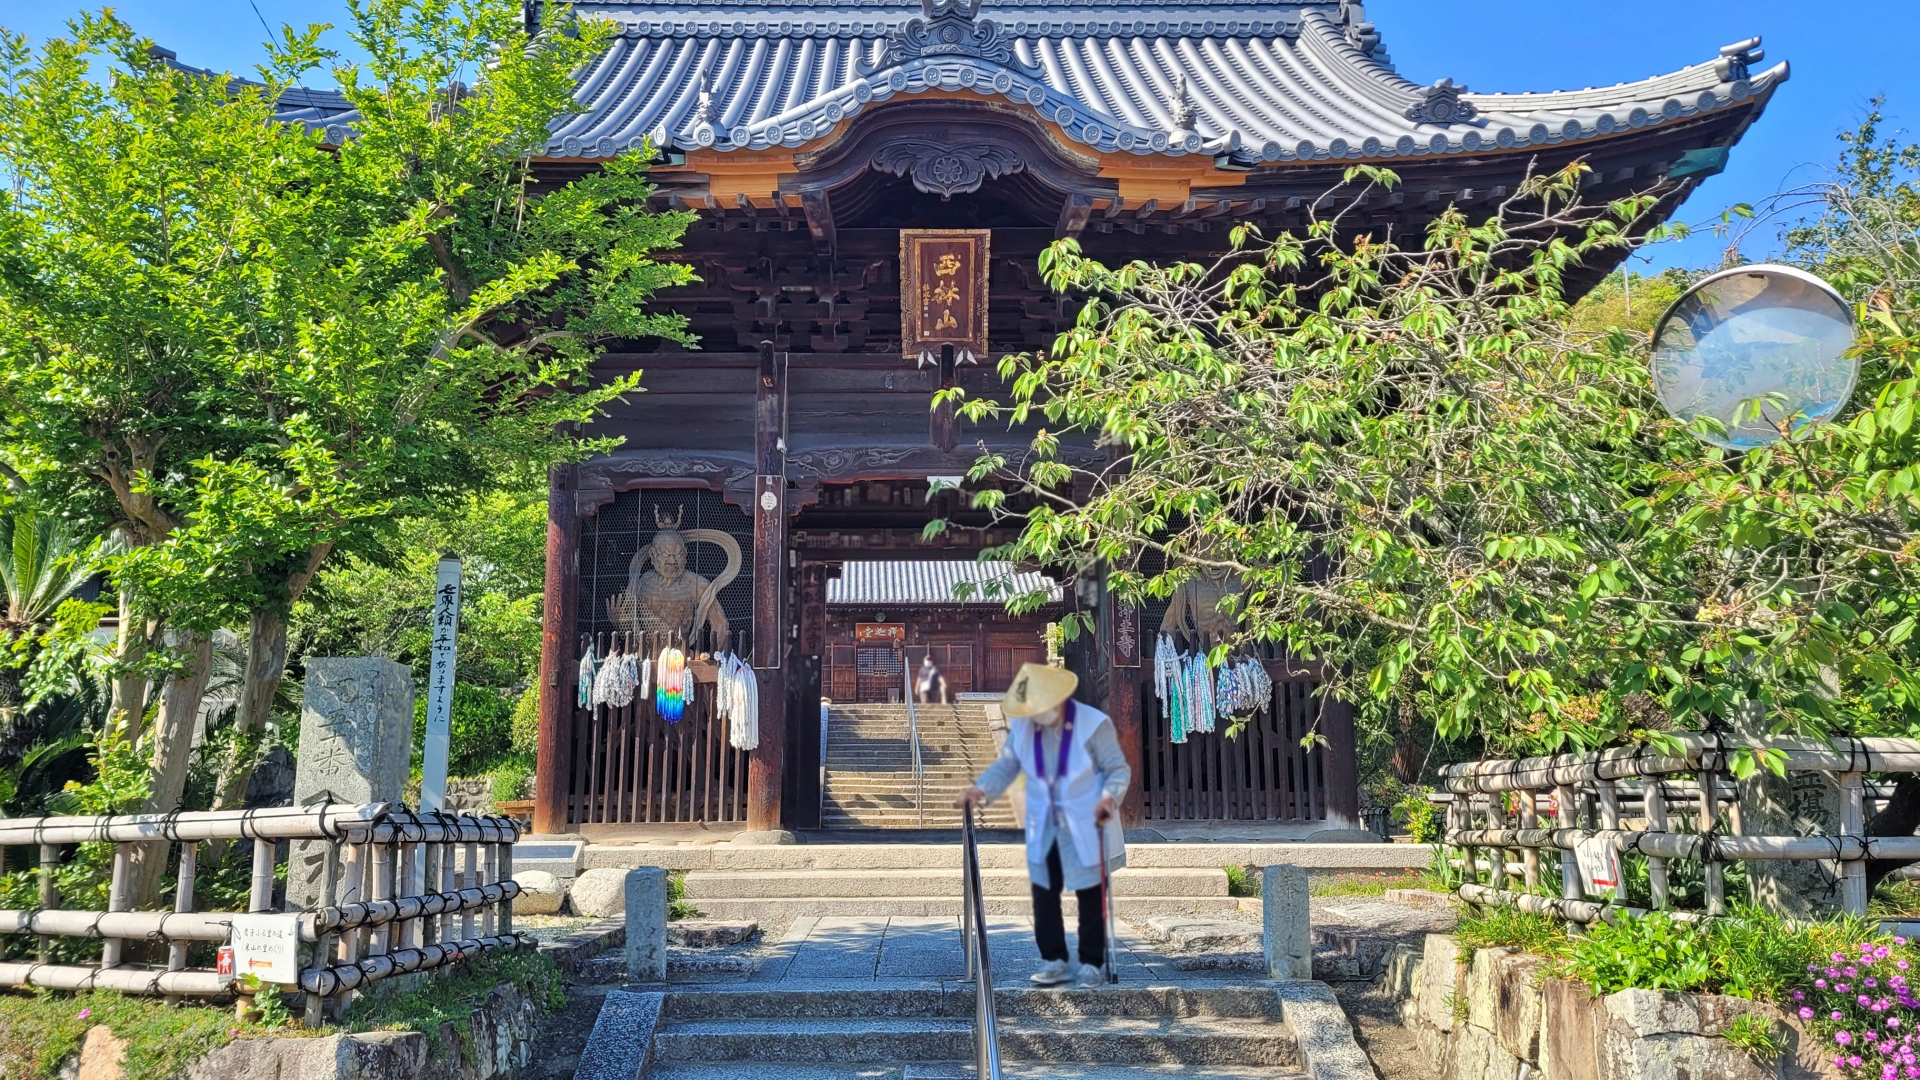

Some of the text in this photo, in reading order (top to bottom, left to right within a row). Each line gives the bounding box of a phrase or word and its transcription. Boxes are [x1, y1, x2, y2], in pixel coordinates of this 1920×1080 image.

[433, 583, 457, 723] 世界人類が平和でありますように
